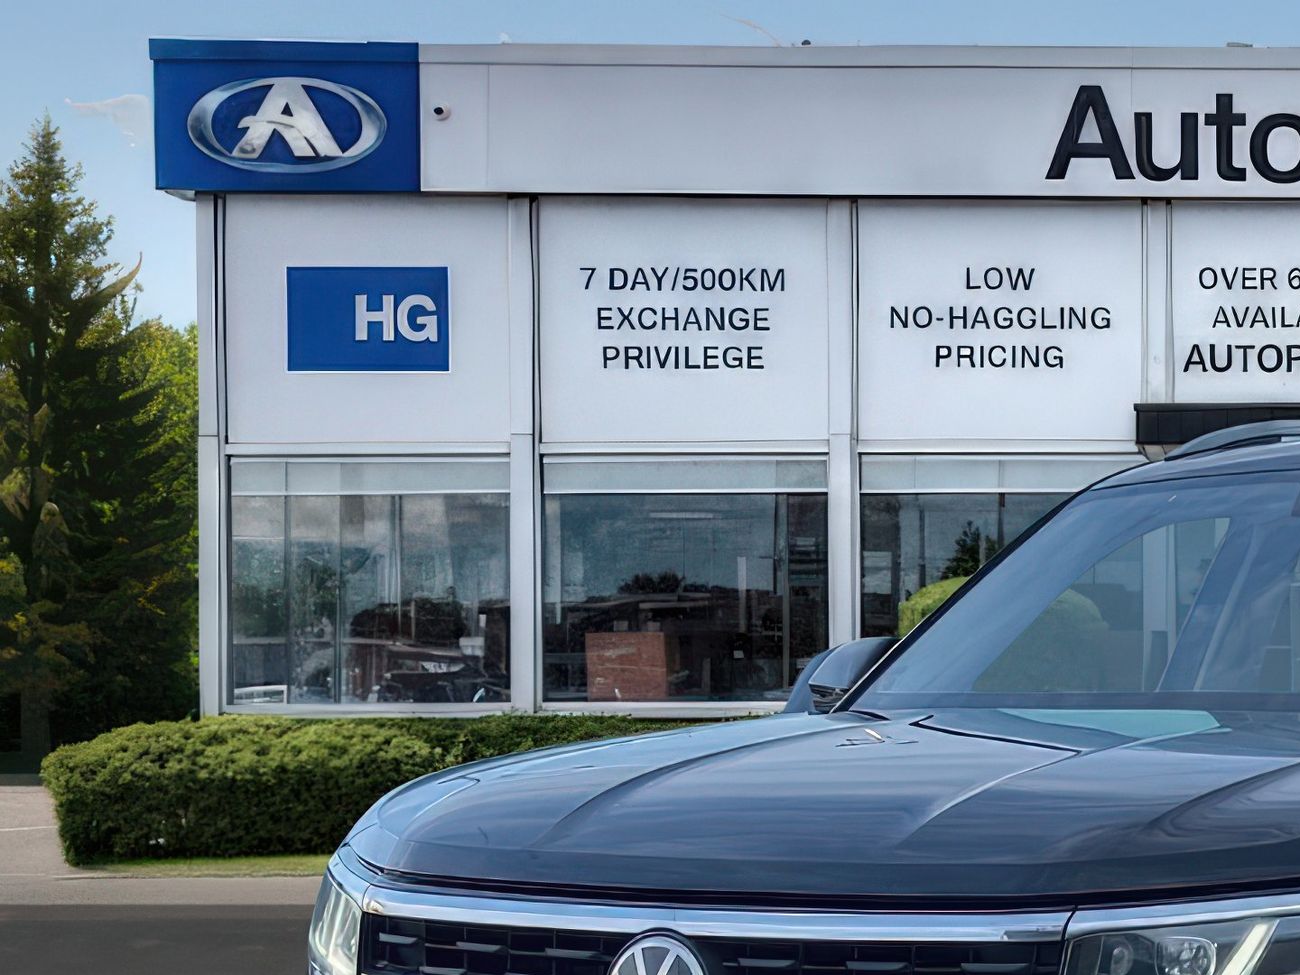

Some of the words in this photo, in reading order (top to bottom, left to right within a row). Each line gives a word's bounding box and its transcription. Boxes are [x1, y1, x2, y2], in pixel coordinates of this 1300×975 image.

[580, 267, 597, 291] 7
[609, 267, 785, 292] DAY/500KM
[965, 266, 1036, 291] LOW
[1198, 266, 1278, 291] OVER
[355, 294, 438, 342] HG
[597, 307, 771, 332] EXCHANGE
[890, 305, 1112, 330] NO-HAGGLING
[602, 346, 765, 370] PRIVILEGE
[935, 344, 1064, 369] PRICING
